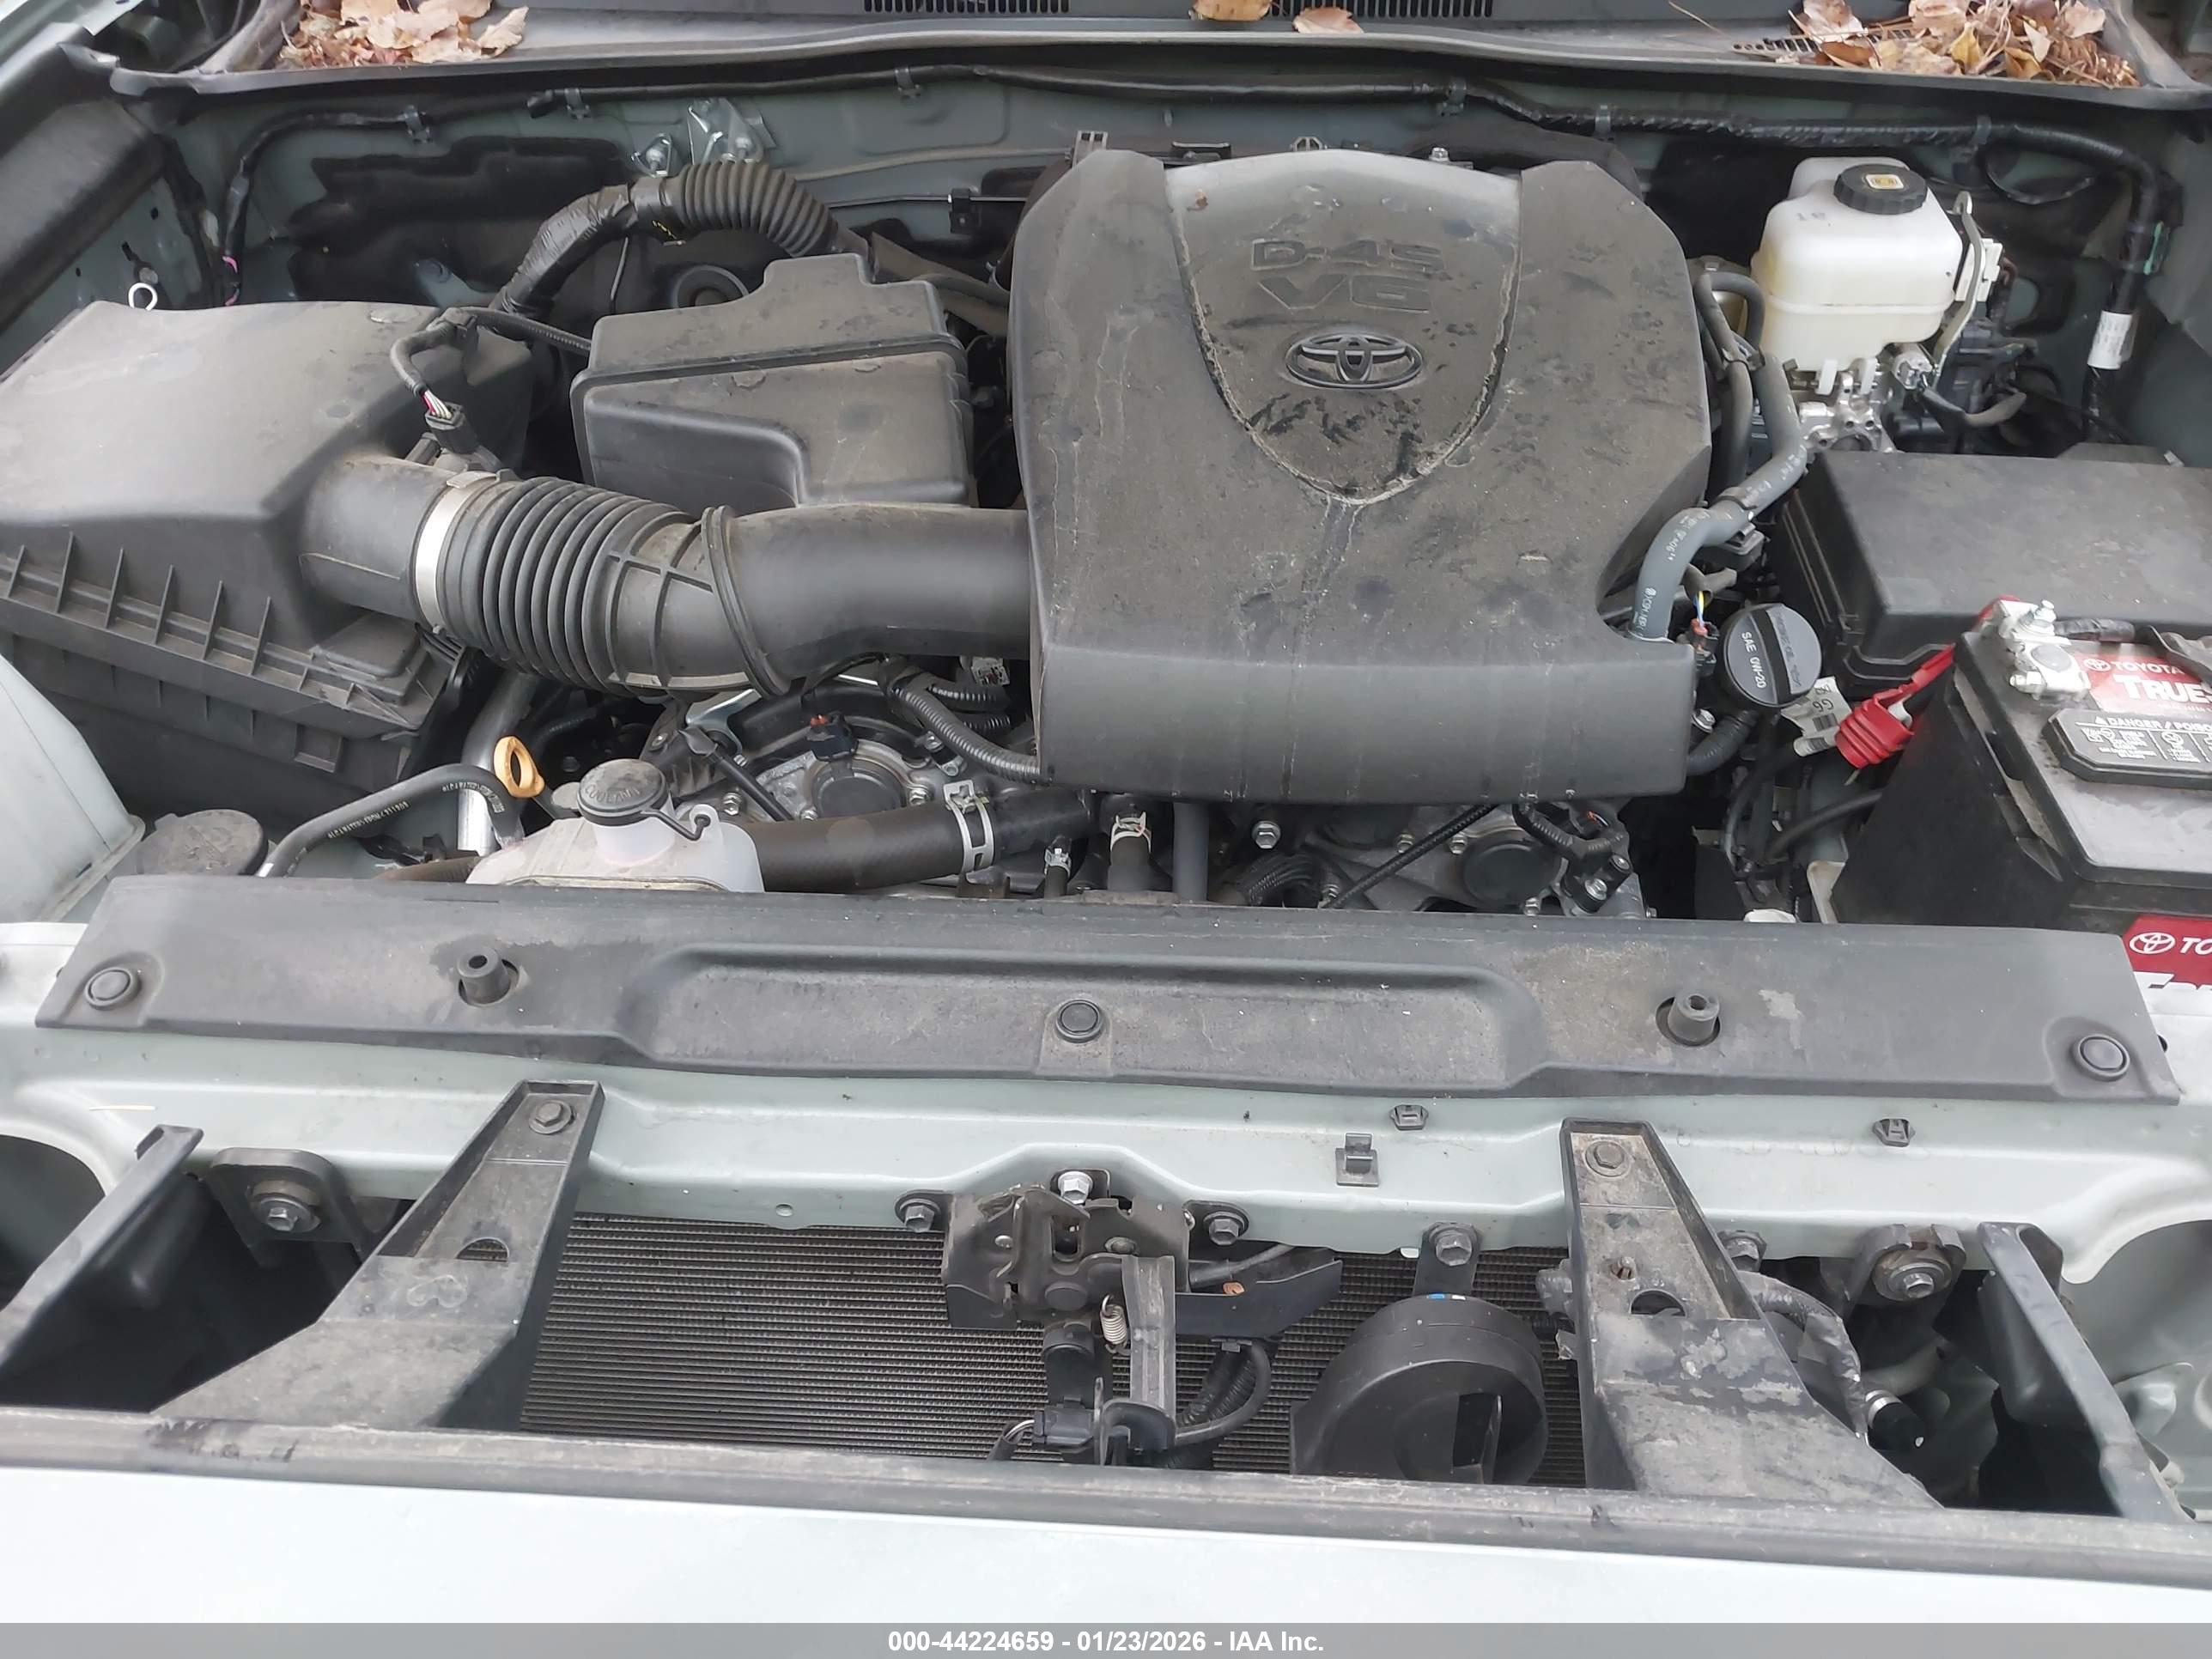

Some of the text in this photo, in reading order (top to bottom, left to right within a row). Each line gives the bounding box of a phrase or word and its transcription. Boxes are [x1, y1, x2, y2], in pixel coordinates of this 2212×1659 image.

[1251, 238, 1446, 273] D-4S
[1257, 273, 1431, 314] V6
[1741, 631, 1767, 689] SAE 0W-20
[2111, 660, 2185, 675] TOYOTA
[2106, 717, 2163, 729] DANGER
